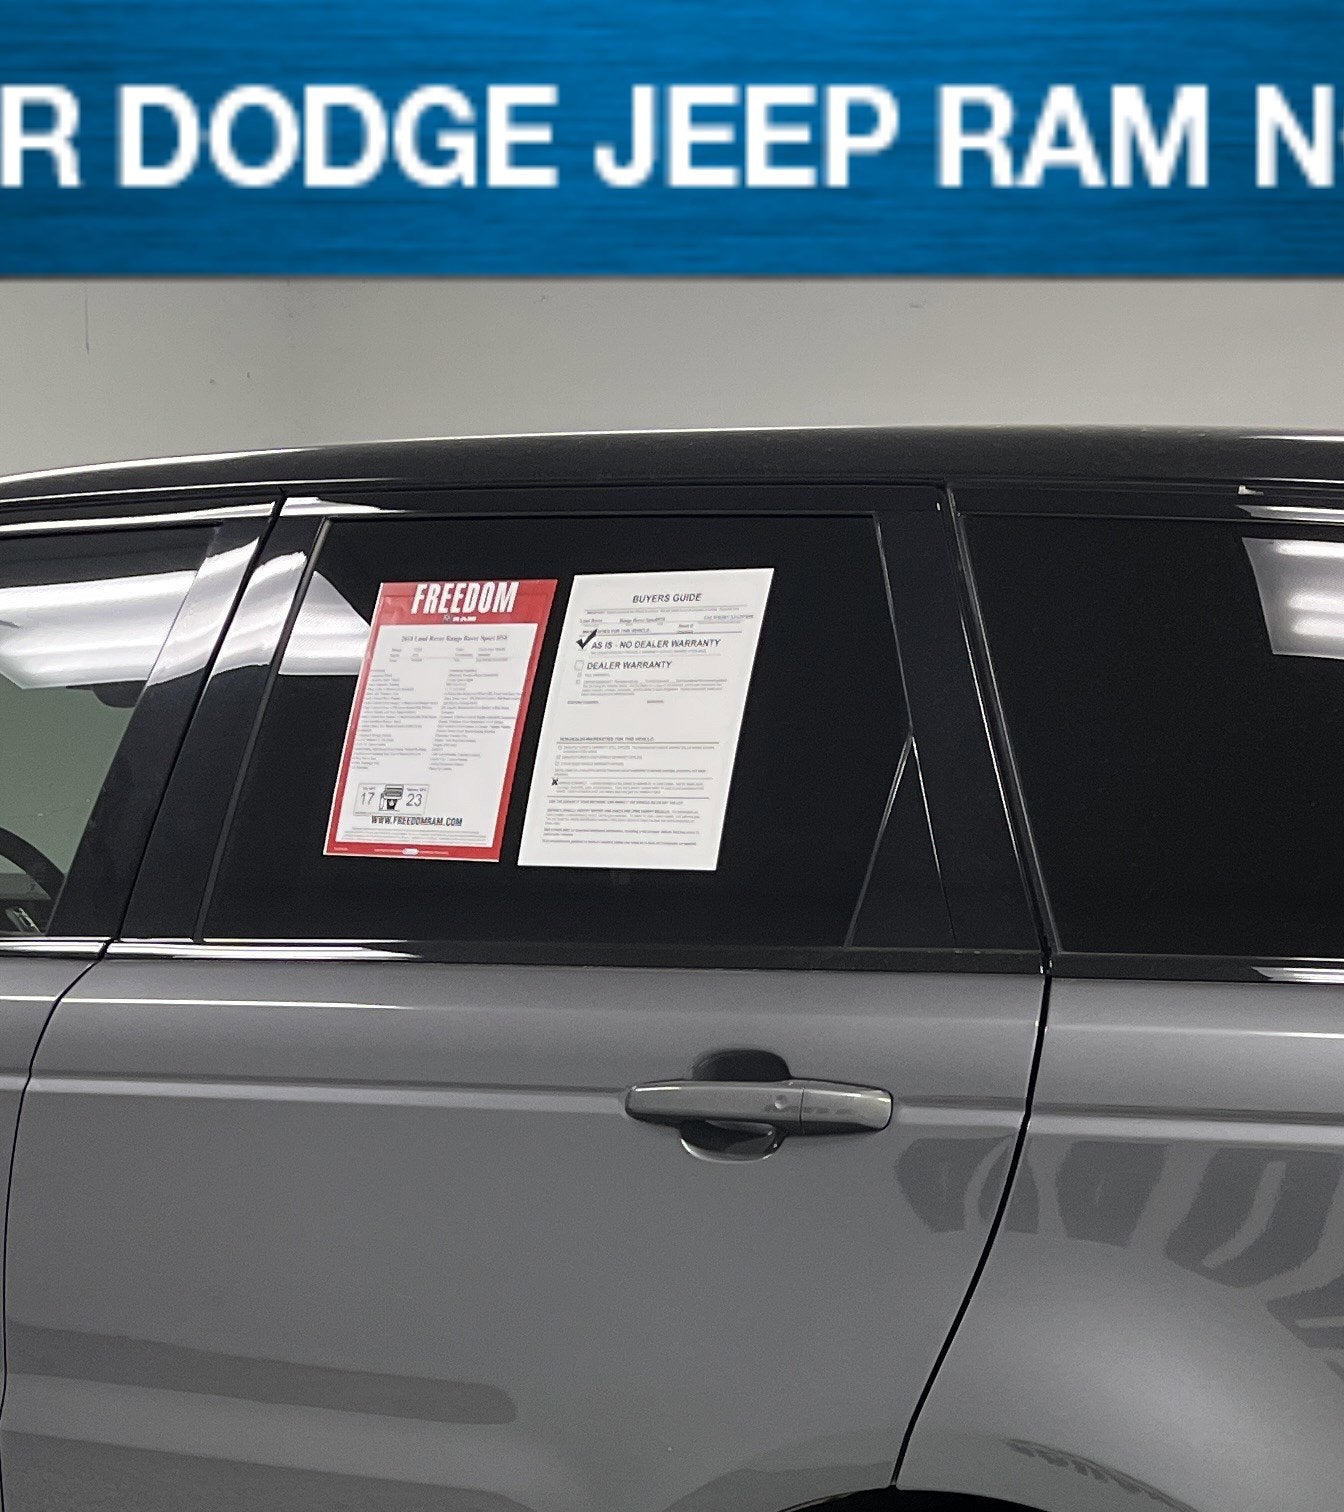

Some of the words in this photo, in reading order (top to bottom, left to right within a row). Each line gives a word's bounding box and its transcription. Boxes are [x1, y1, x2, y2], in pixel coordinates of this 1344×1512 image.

[410, 581, 521, 615] FREEDOM
[632, 594, 671, 604] BUYERS
[672, 593, 703, 602] GUIDE
[591, 641, 603, 650] AS
[604, 641, 613, 650] IS
[619, 640, 632, 649] NO
[634, 640, 669, 649] DEALER
[671, 639, 721, 648] WARRANTY
[586, 661, 621, 670] DEALER
[622, 661, 673, 669] WARRANTY
[360, 792, 375, 806] 17
[405, 793, 423, 807] 23
